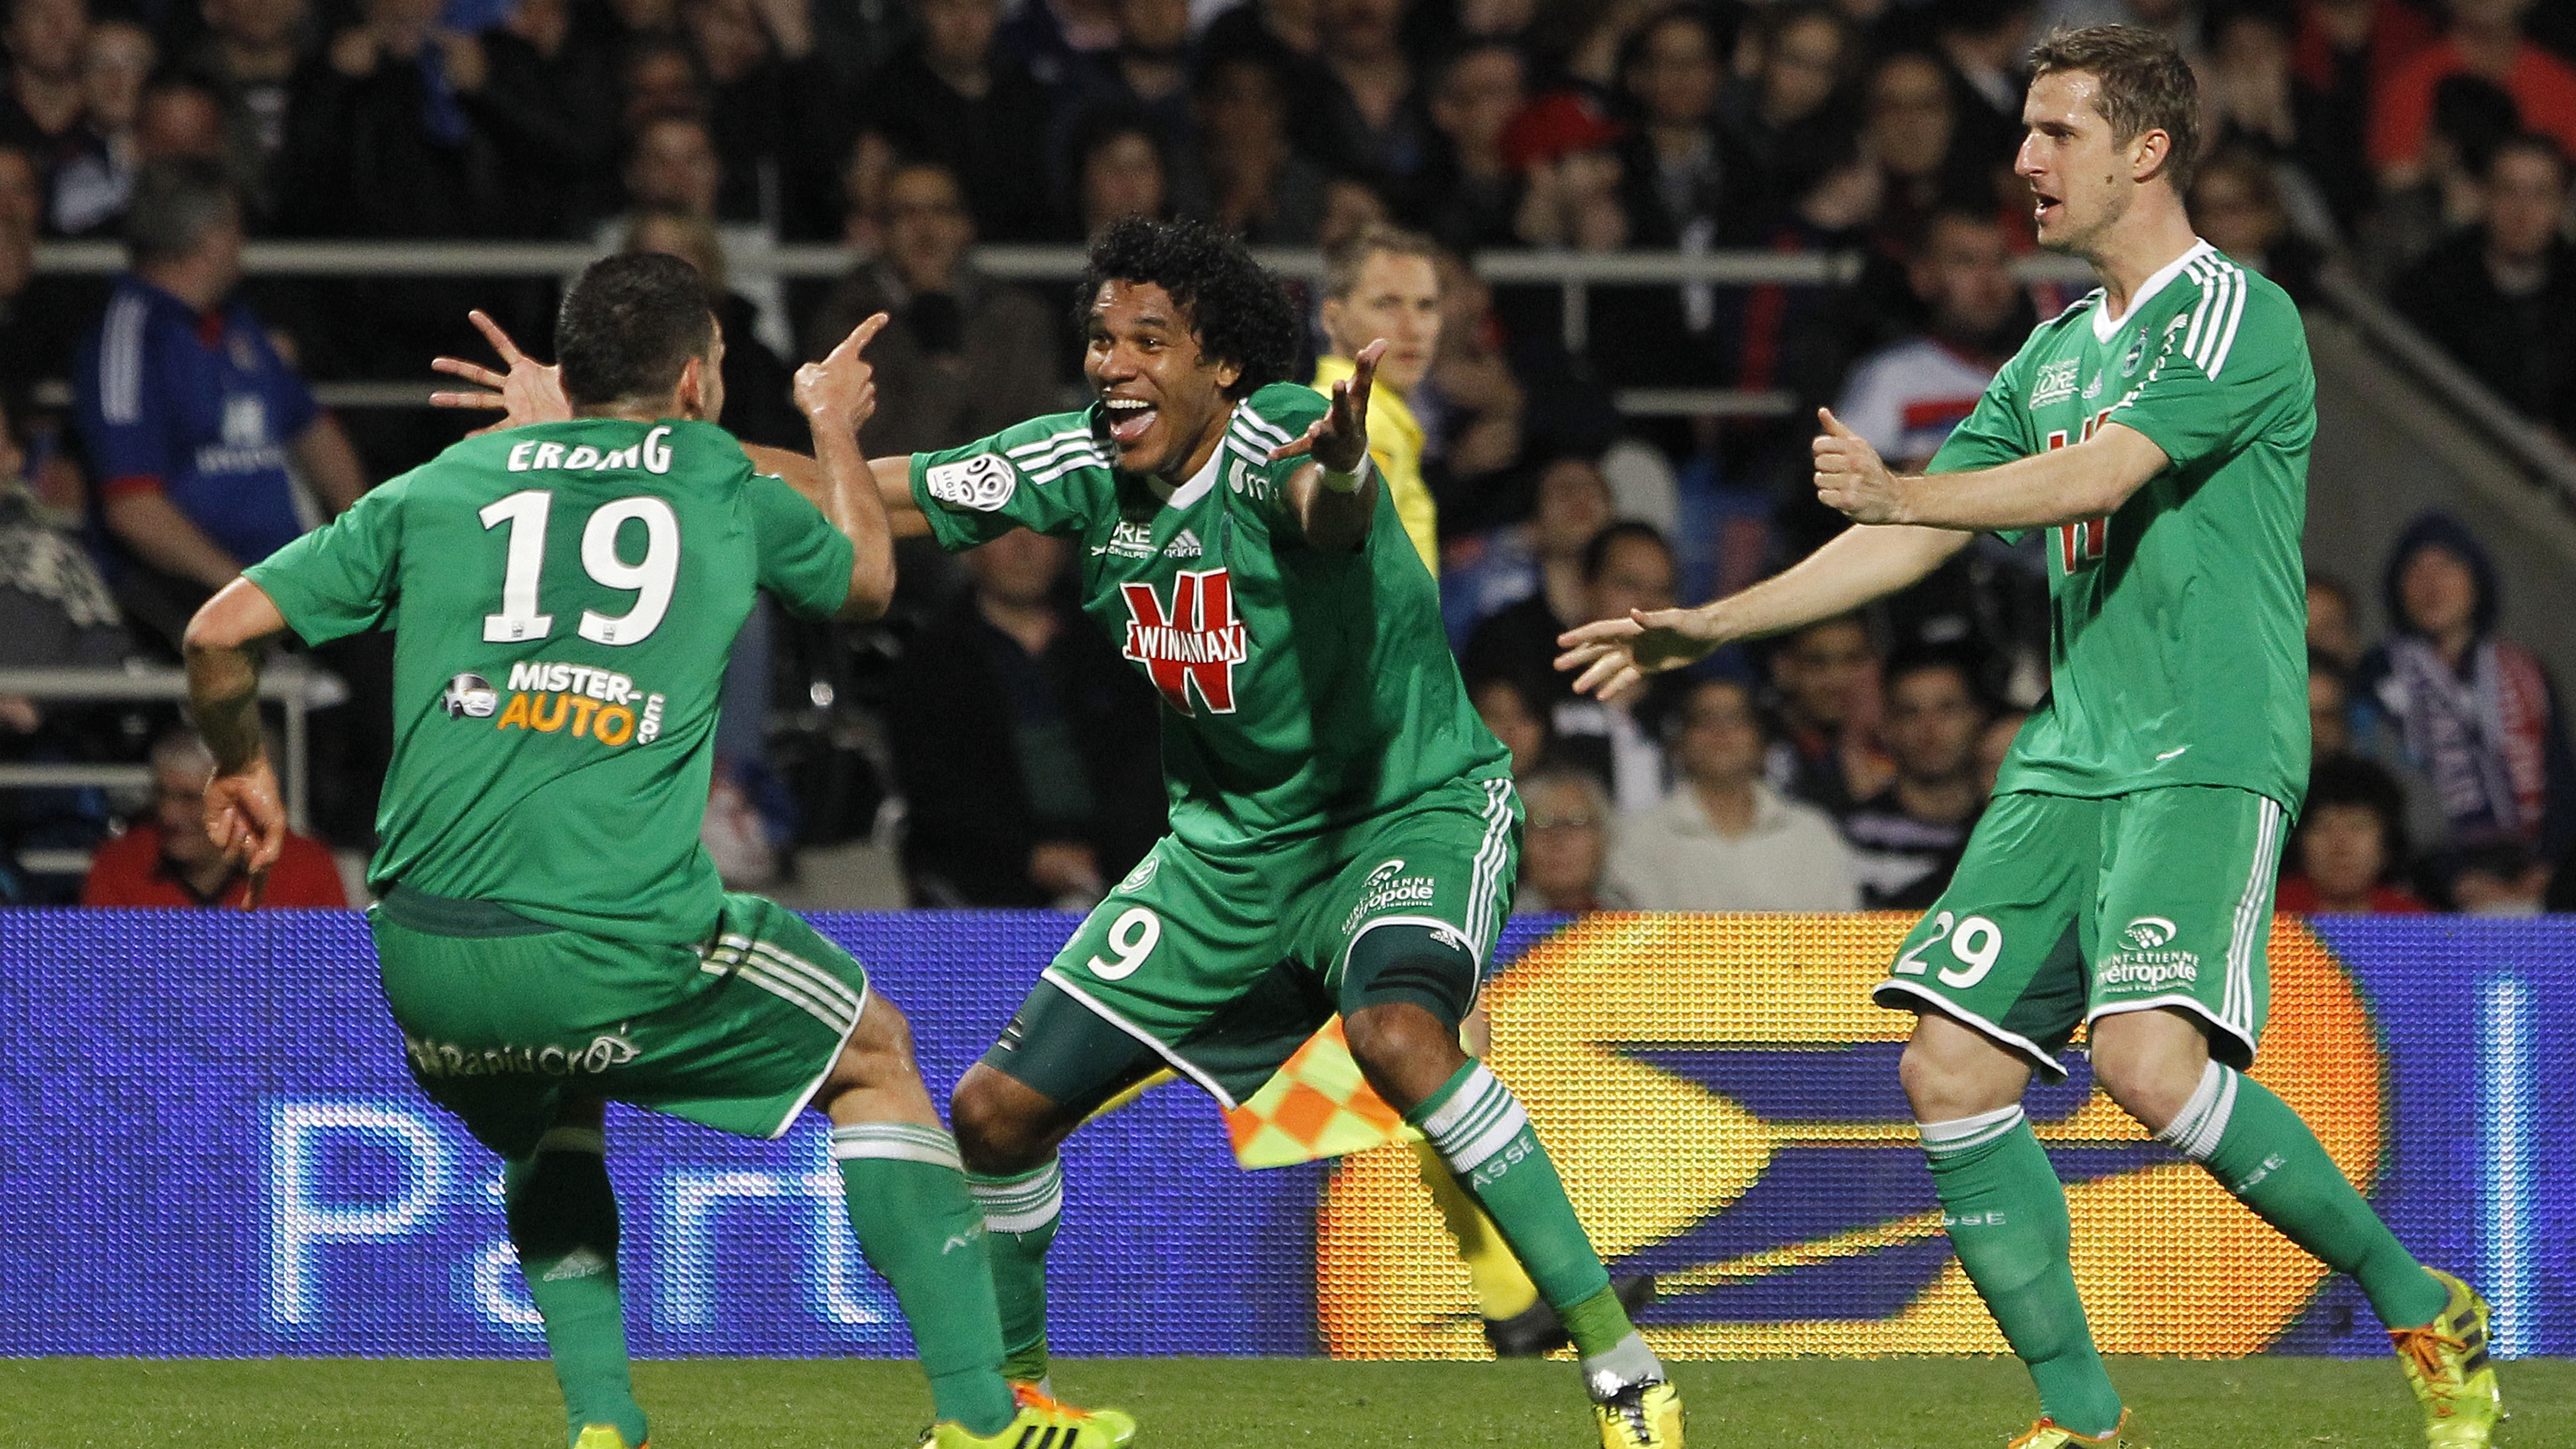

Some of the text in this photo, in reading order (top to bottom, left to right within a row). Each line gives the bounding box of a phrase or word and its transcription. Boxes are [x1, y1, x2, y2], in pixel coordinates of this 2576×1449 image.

[479, 489, 681, 646] 19
[1136, 626, 1240, 664] WINAMAX
[508, 661, 643, 706] MISTER-
[497, 693, 635, 747] AUTO
[1088, 907, 1161, 981] 9
[1895, 911, 2002, 989] 29
[1471, 1136, 1535, 1193] ASSE
